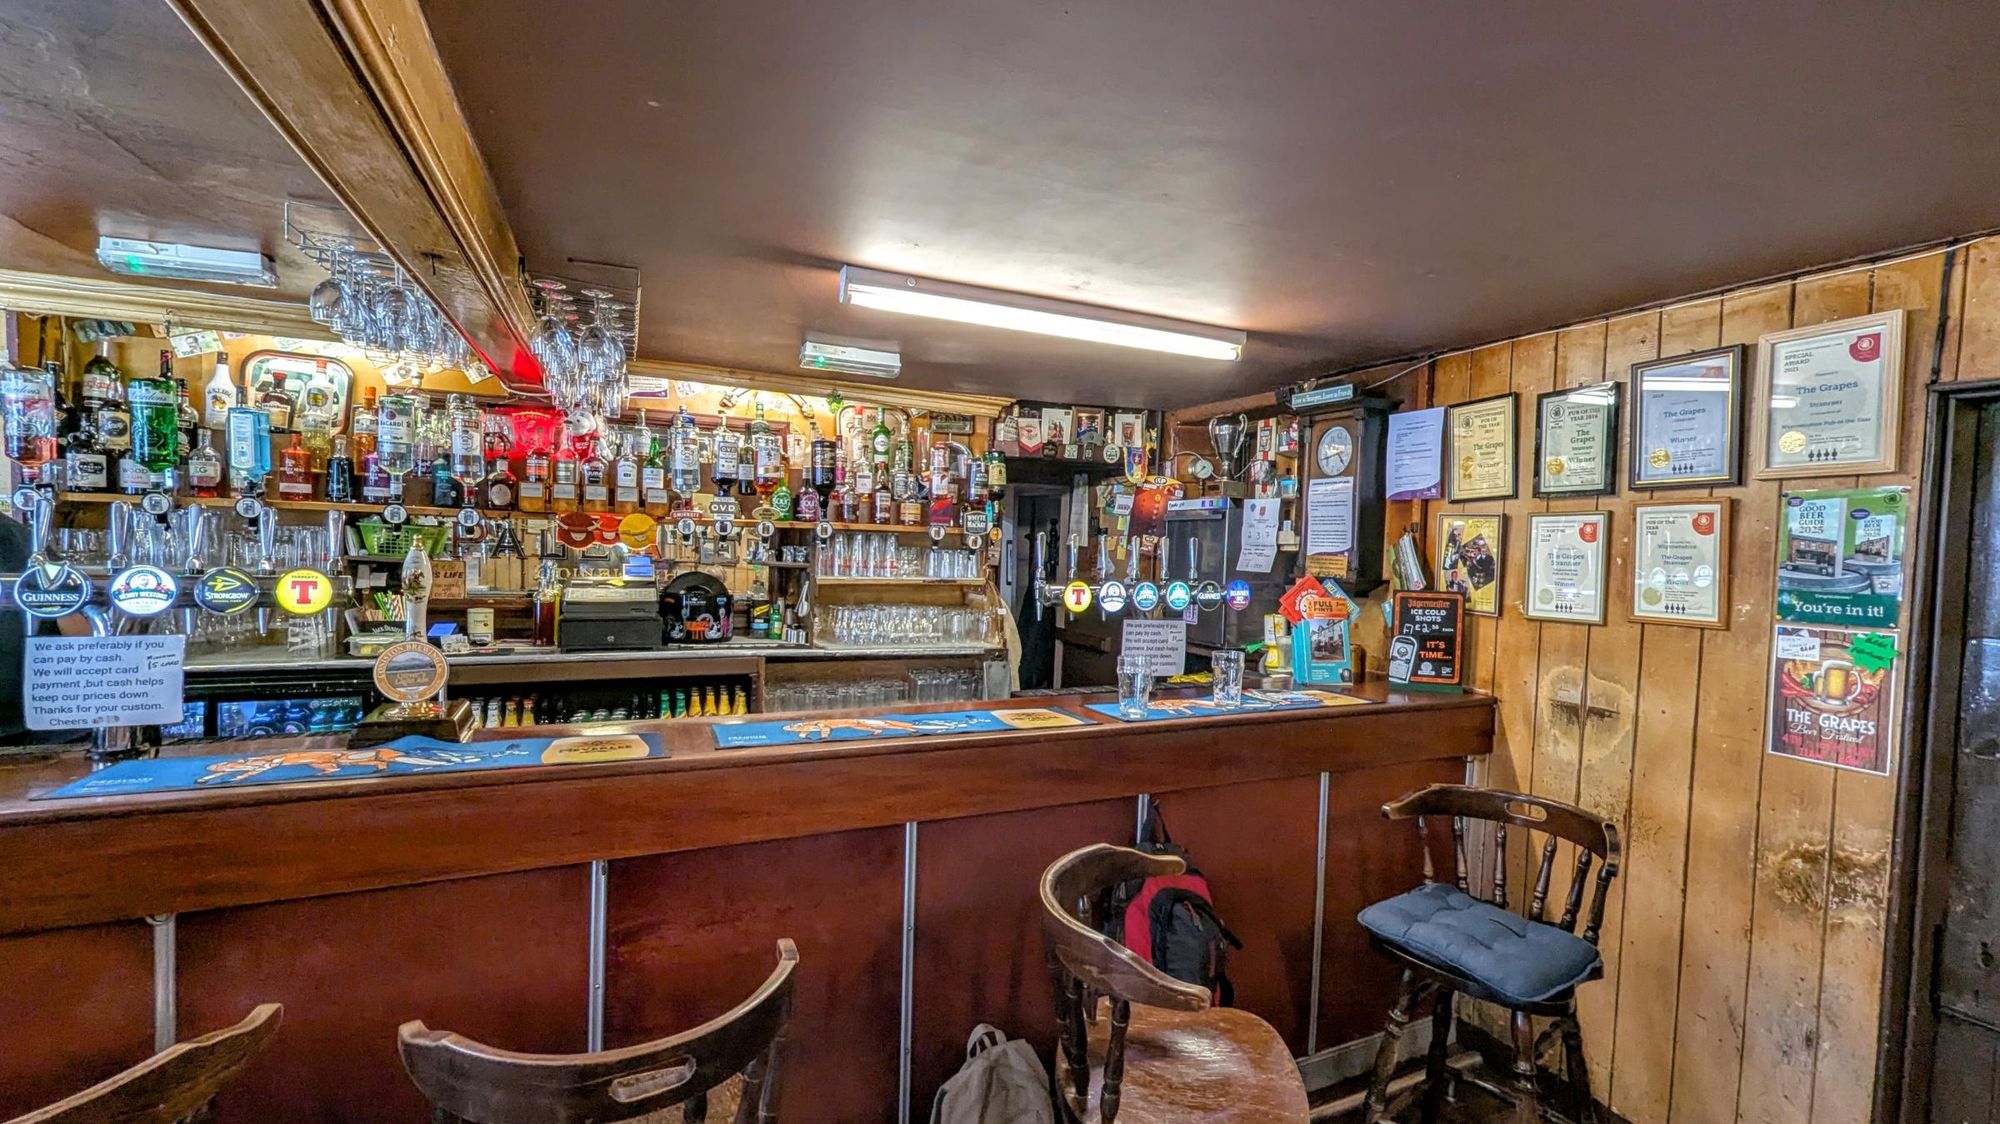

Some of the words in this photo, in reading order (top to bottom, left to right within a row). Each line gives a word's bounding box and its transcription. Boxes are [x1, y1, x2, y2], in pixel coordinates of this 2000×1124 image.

[1796, 386, 1816, 394] The
[1820, 381, 1858, 392] Grapes
[1664, 410, 1678, 418] The
[1680, 407, 1706, 416] Grapes
[1570, 436, 1595, 444] Grapes
[1485, 442, 1504, 450] Grapes
[1799, 526, 1824, 534] 2025
[22, 592, 79, 602] GUINNESS
[205, 592, 249, 600] STRONGBOW
[291, 580, 318, 604] T
[1072, 588, 1085, 605] T
[1794, 600, 1842, 614] You're
[1846, 604, 1863, 616] in
[1868, 605, 1884, 618] it!
[56, 642, 74, 650] ask
[78, 641, 132, 651] preferably
[145, 641, 164, 651] you
[57, 657, 76, 666] pay
[80, 655, 93, 664] by
[55, 667, 72, 675] will
[76, 667, 112, 678] accept
[115, 666, 139, 674] card
[32, 680, 80, 691] payment
[107, 679, 133, 687] cash
[135, 678, 164, 687] helps
[32, 694, 59, 703] keep
[84, 690, 116, 702] prices
[34, 706, 72, 715] Thanks
[77, 705, 91, 713] for
[95, 704, 117, 716] your
[50, 717, 88, 726] Cheers
[1786, 708, 1812, 724] THE
[1819, 714, 1875, 735] GRAPES
